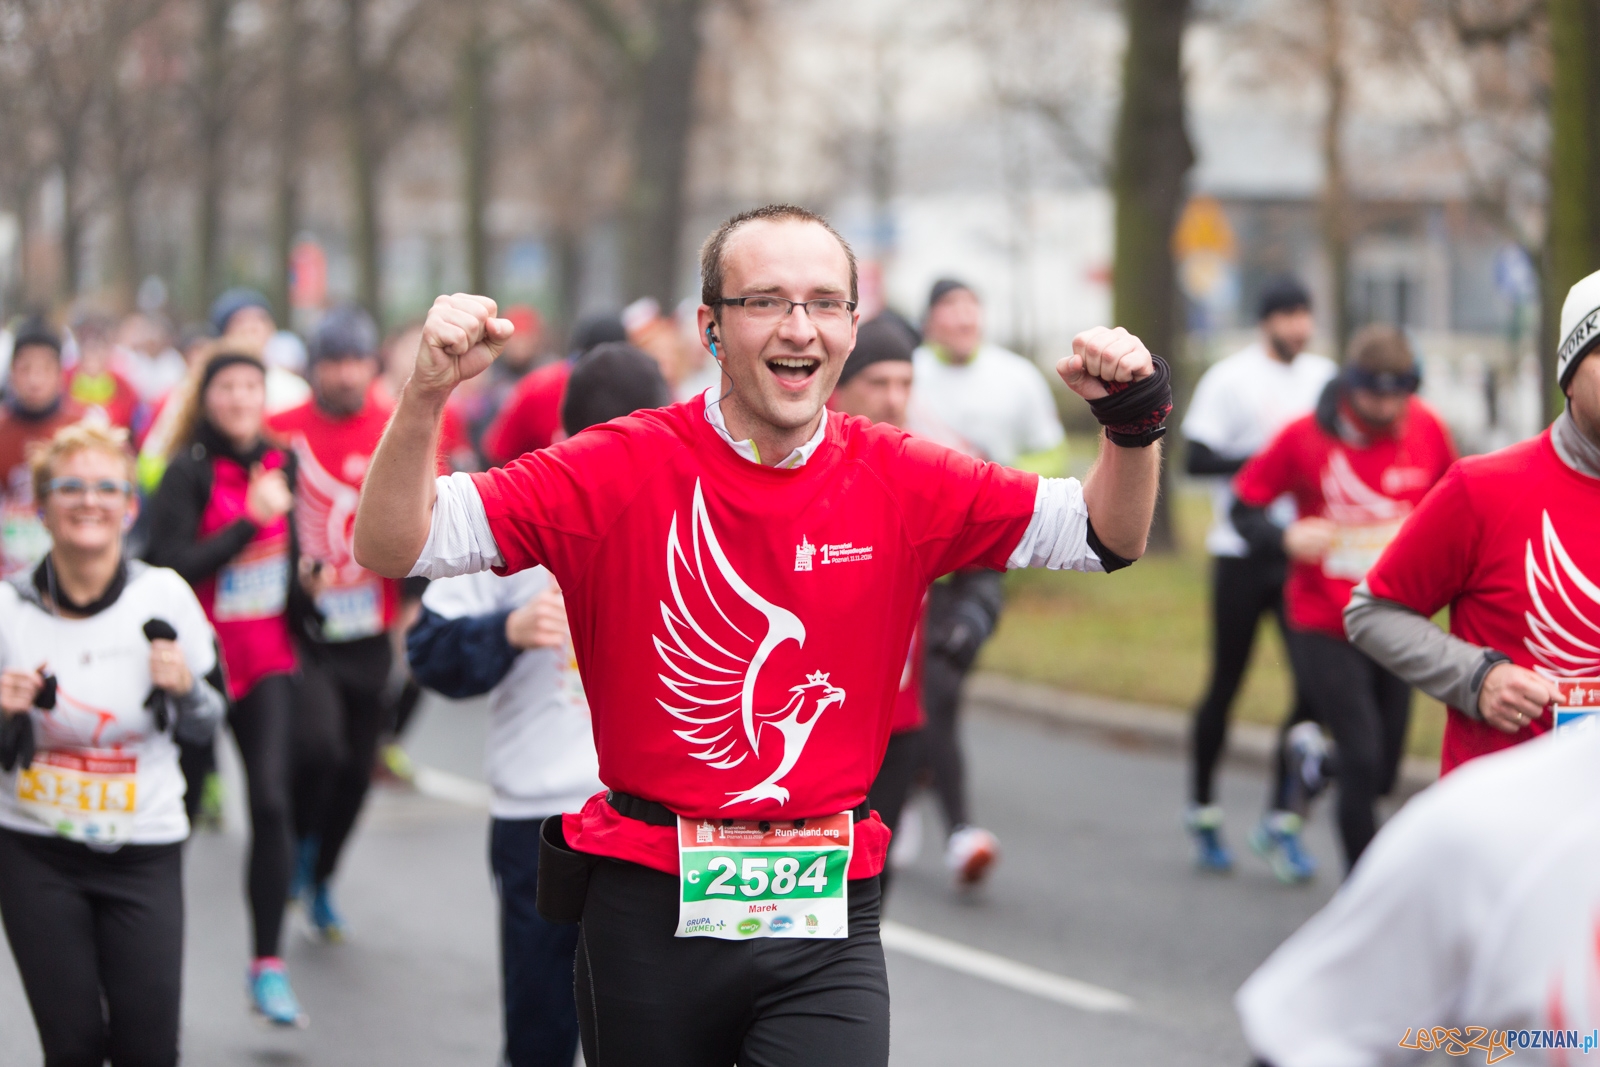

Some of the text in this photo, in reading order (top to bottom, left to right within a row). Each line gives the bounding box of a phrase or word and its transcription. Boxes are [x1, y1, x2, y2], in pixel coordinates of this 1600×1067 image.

[820, 544, 830, 564] 1
[718, 825, 726, 838] 1
[775, 827, 840, 838] RunPoland.org
[704, 856, 828, 897] 2584
[748, 903, 778, 913] Marek
[686, 917, 711, 927] GRUPA
[684, 924, 716, 934] LUXMED
